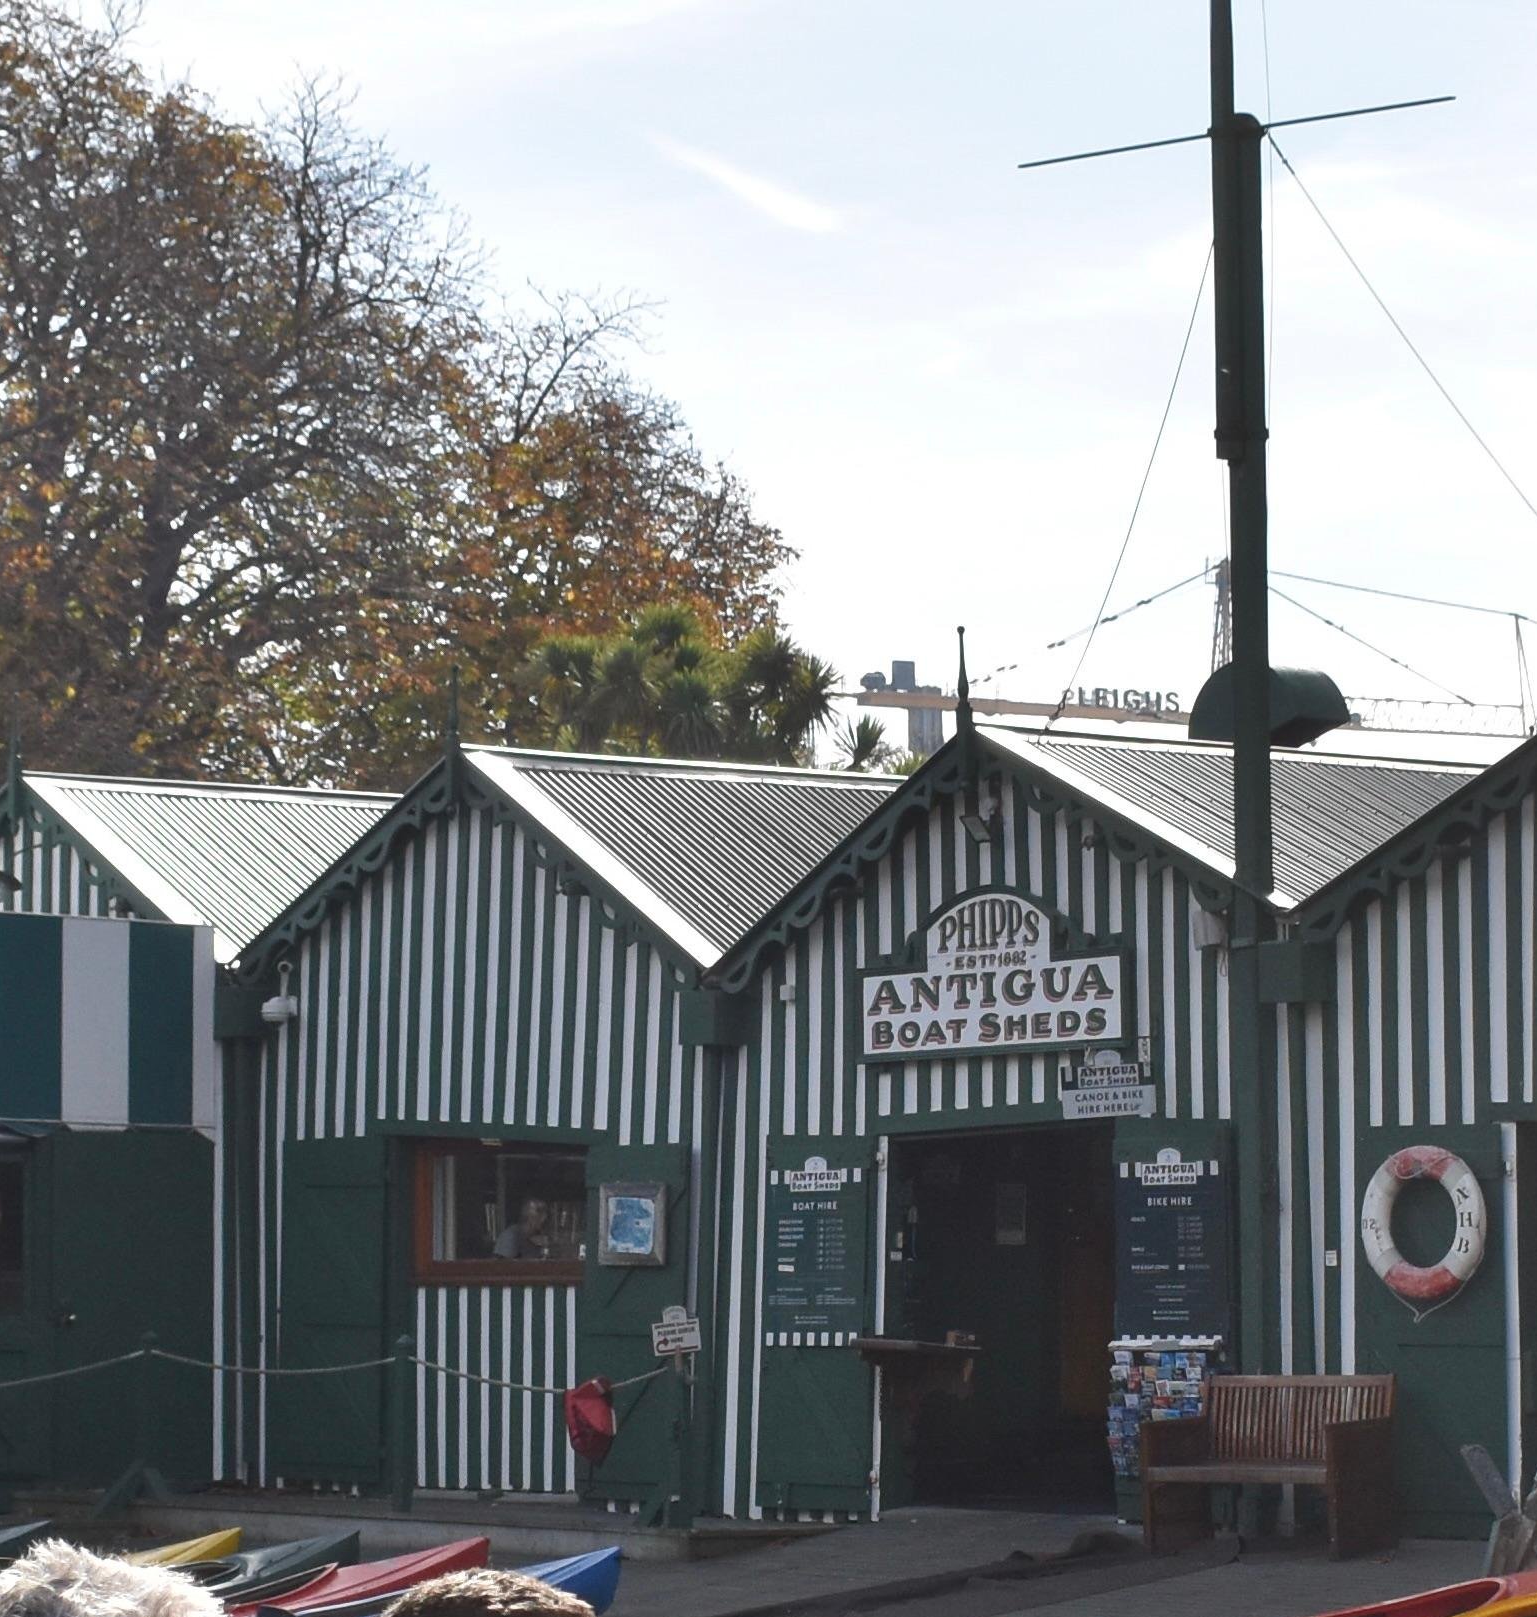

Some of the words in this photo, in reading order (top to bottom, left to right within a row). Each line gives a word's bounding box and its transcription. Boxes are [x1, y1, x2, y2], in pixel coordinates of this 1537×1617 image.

[937, 898, 1040, 953] PHIPPS
[867, 963, 1114, 1016] ANTIGUA
[872, 1019, 967, 1049] BOAT
[978, 1007, 1107, 1043] SHEDS
[1080, 1065, 1137, 1077] ANTIGUA
[1075, 1092, 1109, 1102] CANOE
[1113, 1092, 1119, 1100] &
[1122, 1090, 1143, 1099] BIKE
[1077, 1104, 1101, 1114] HIRE
[1103, 1103, 1129, 1112] HERE
[1144, 1165, 1194, 1175] ANTIGUA
[792, 1172, 839, 1181] ANTIGUA
[1143, 1175, 1165, 1184] BOAT
[792, 1202, 815, 1211] BOAT
[817, 1201, 837, 1210] HIRE
[1147, 1197, 1168, 1207] BIKE
[1170, 1196, 1192, 1206] HIRE
